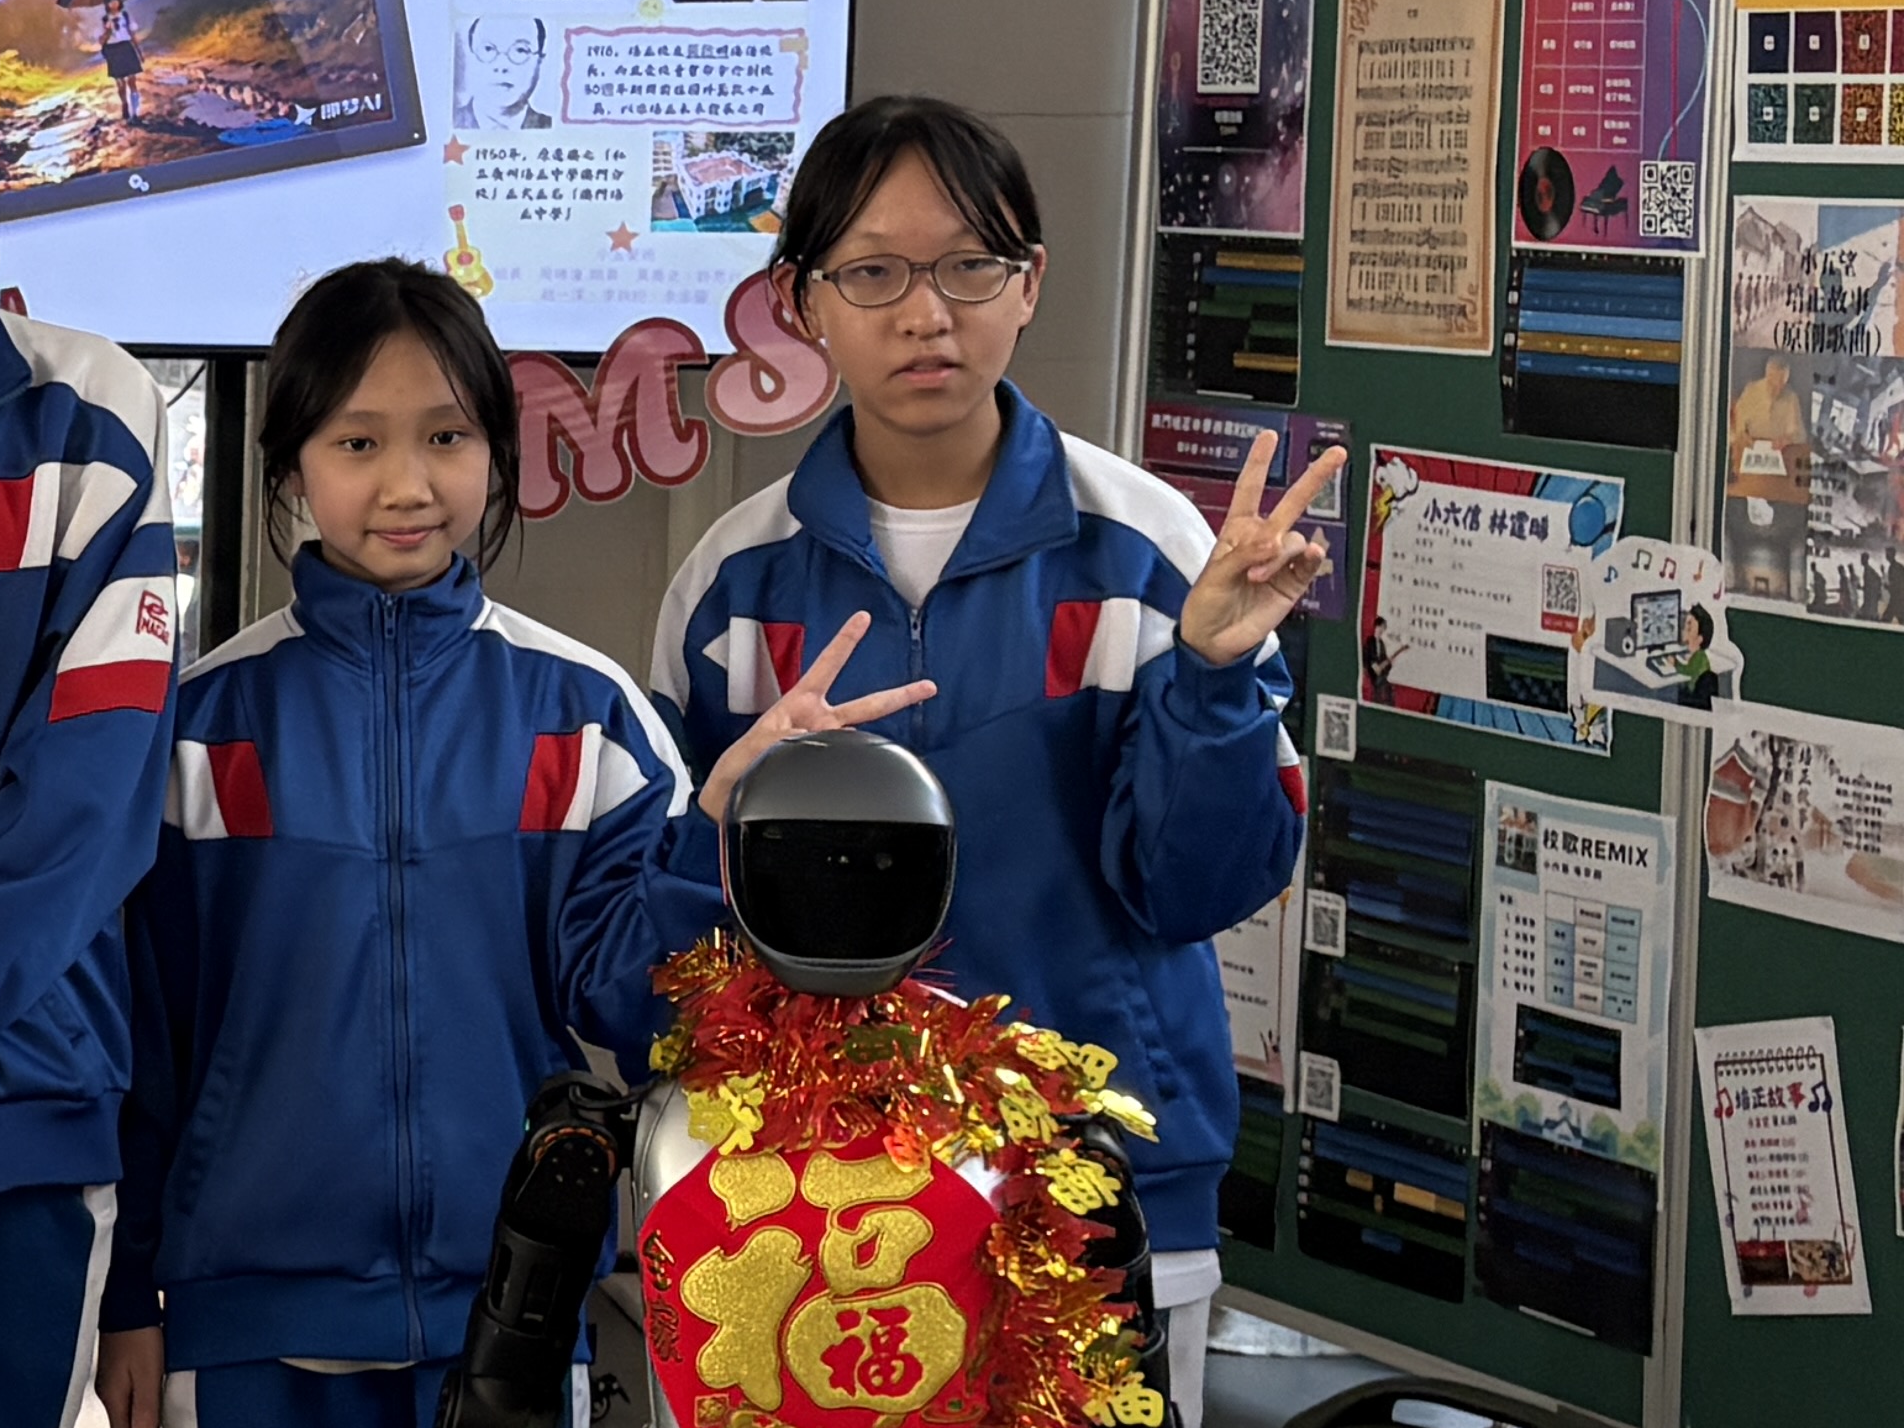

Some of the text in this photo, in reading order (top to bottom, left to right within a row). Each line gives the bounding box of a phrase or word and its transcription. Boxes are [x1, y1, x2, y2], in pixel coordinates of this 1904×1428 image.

[1786, 286, 1872, 317] 培正故事
[1423, 497, 1483, 533] 小六信
[1542, 828, 1649, 869] 校歌REMIX
[1735, 1081, 1807, 1111] 培正故事
[680, 1149, 968, 1414] 福
[819, 1307, 924, 1399] 福
